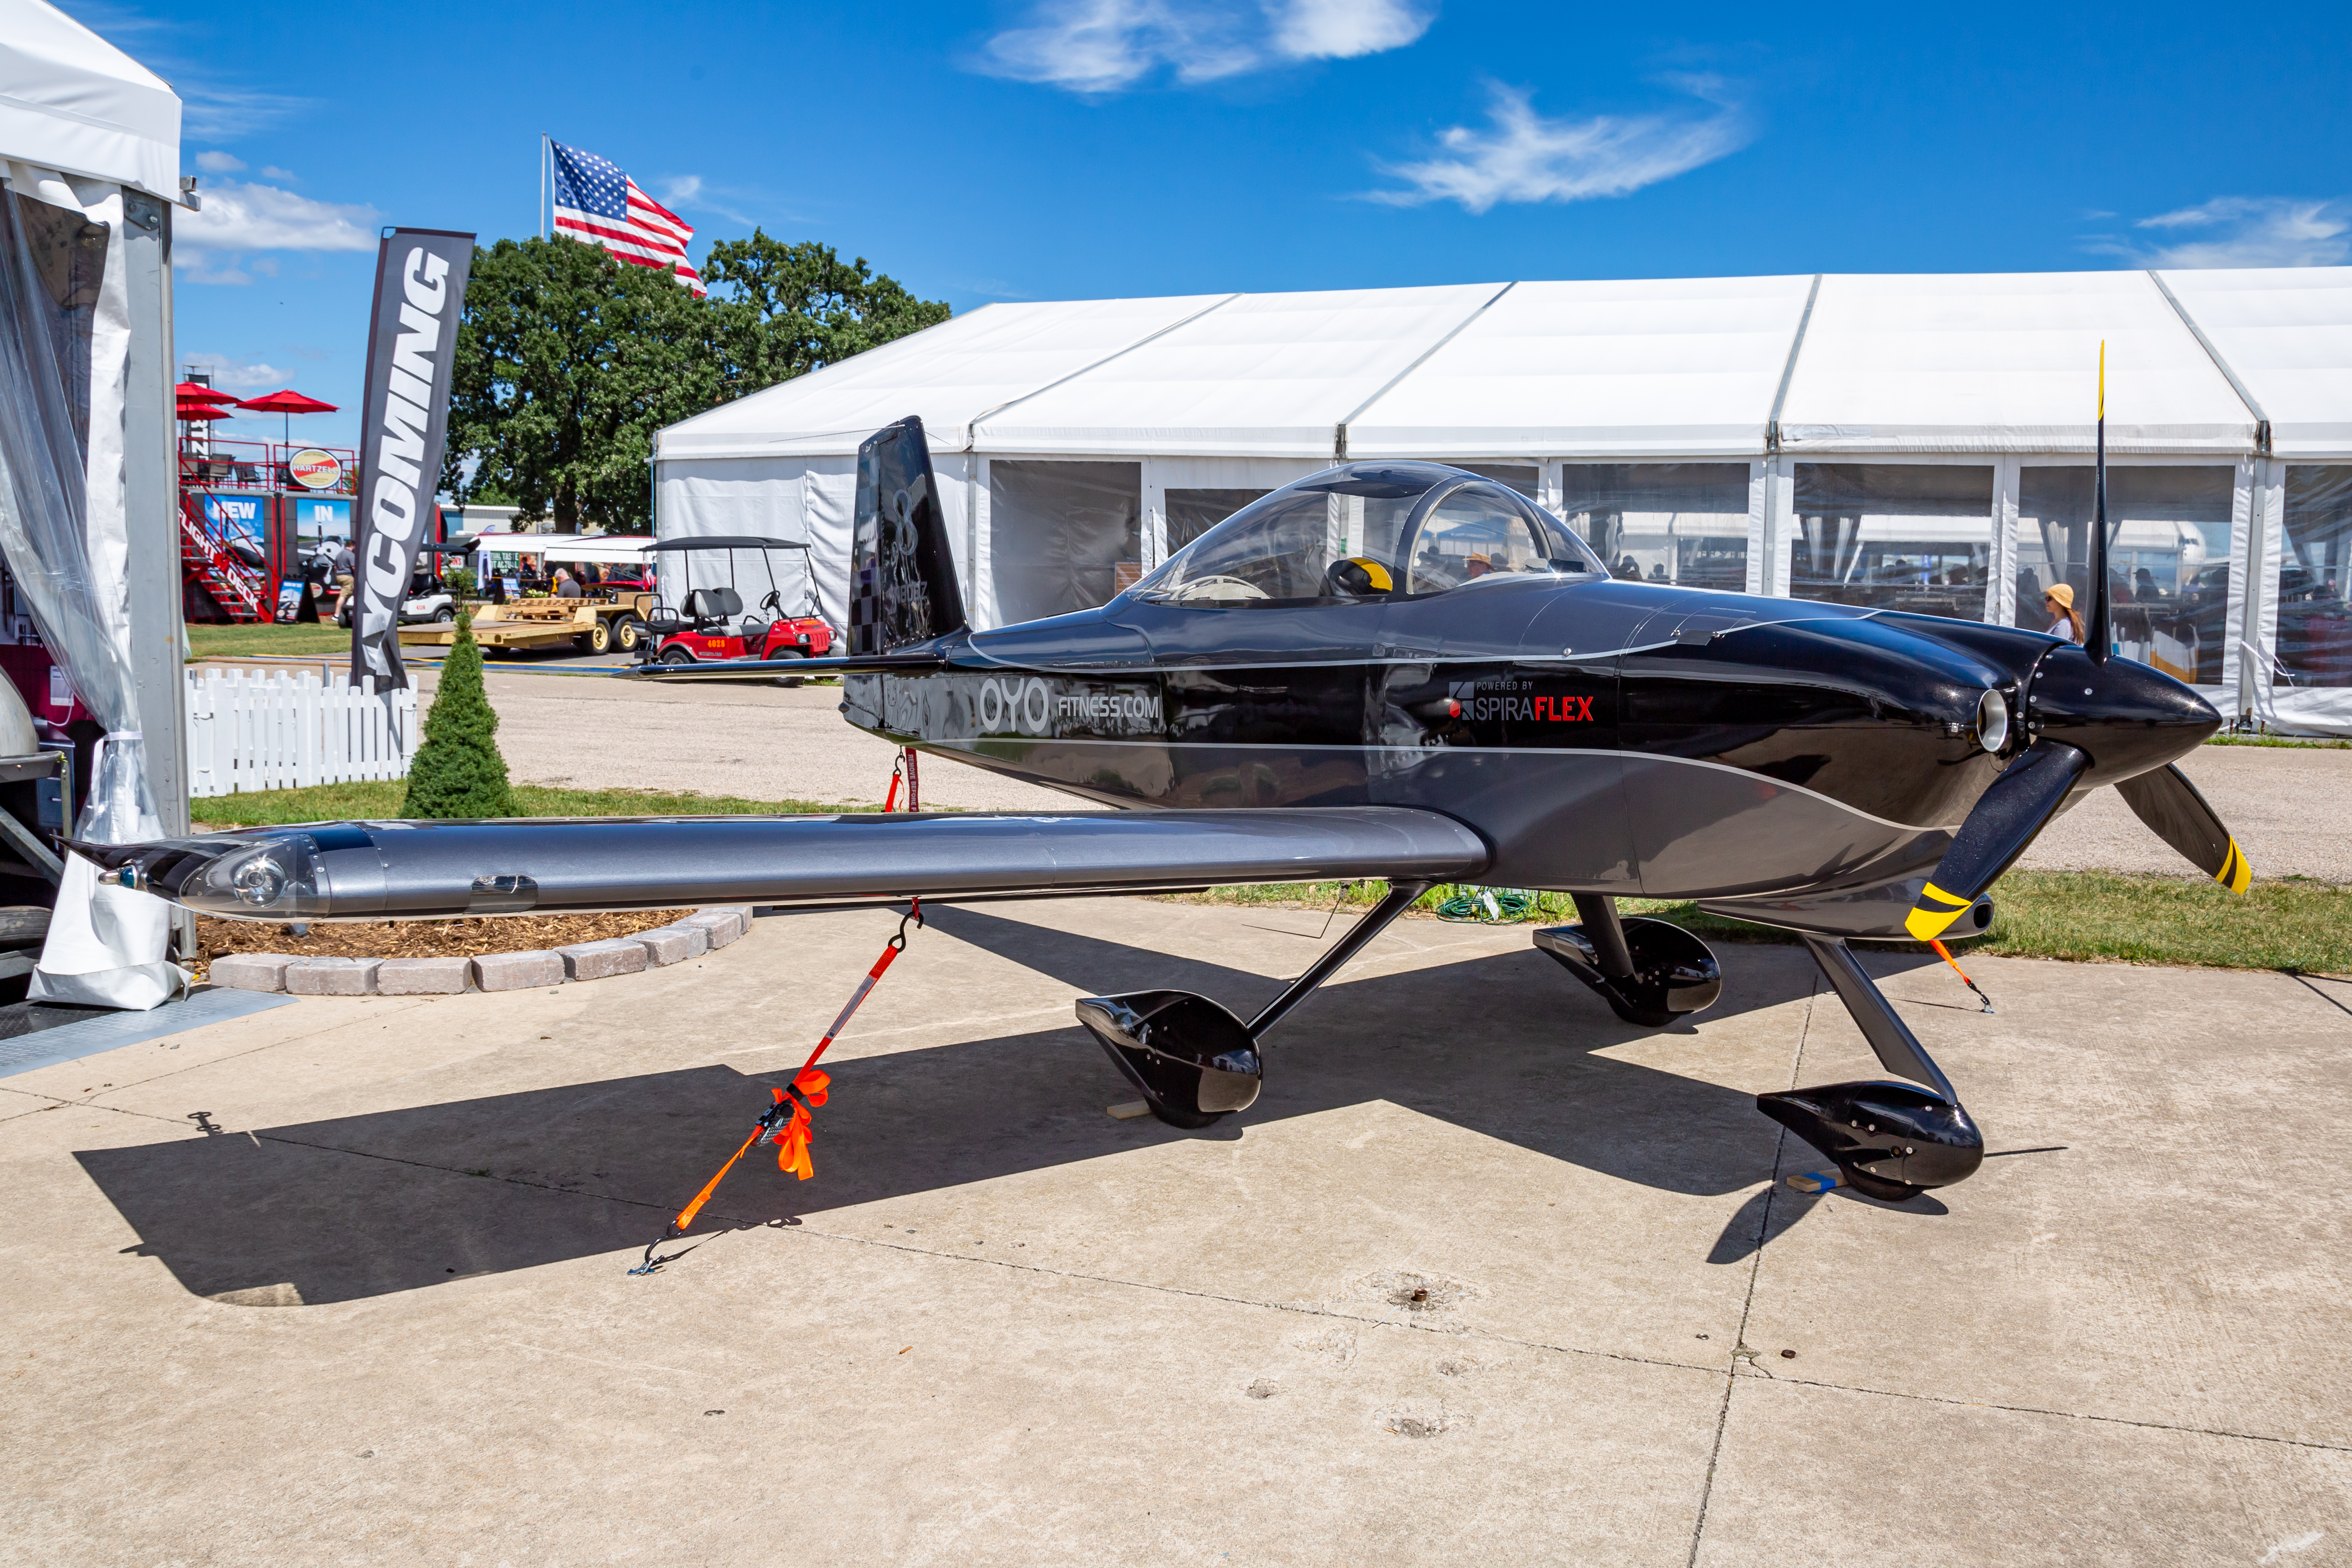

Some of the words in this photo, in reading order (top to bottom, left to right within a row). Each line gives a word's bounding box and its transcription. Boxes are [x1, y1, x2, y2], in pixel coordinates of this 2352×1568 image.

[293, 464, 338, 474] HARTZELL
[212, 501, 256, 519] NEW
[314, 505, 333, 521] IN
[227, 567, 258, 612] DECK
[707, 639, 725, 648] 4028
[1477, 681, 1517, 691] POWERED
[1522, 681, 1533, 690] BY
[1058, 696, 1159, 718] FITNESS.COM
[1476, 696, 1594, 721] SPIRAFLEX
[907, 754, 916, 779] REMOVE
